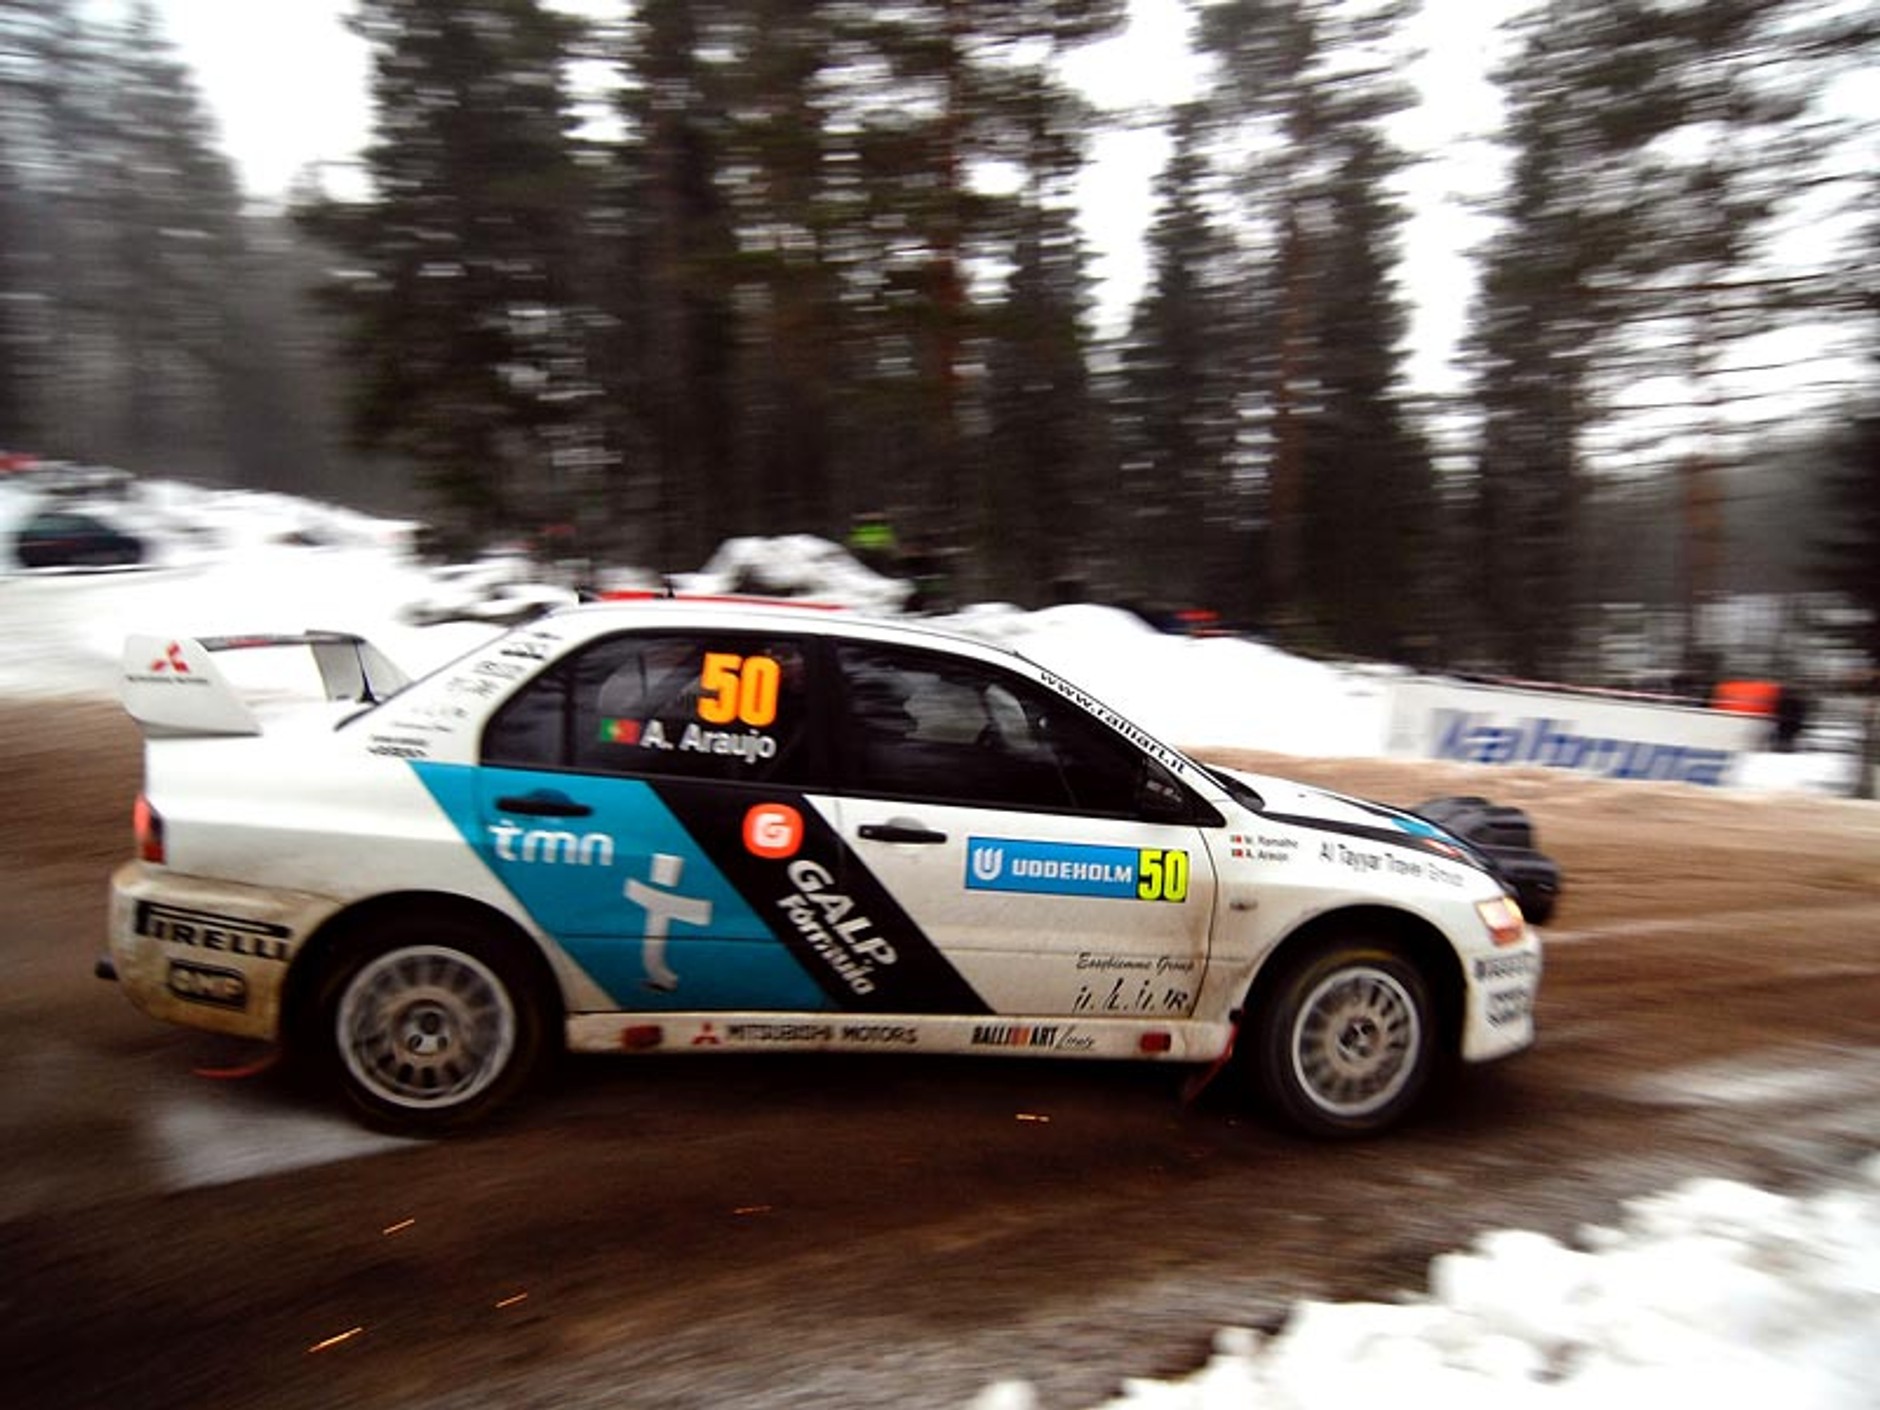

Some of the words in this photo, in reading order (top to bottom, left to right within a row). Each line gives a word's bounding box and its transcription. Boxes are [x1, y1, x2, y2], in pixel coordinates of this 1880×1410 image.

[697, 652, 782, 727] 50
[640, 718, 674, 750] A.
[678, 722, 777, 764] Araujo
[1040, 672, 1187, 775] www.ralliart.it
[488, 820, 614, 867] tmn
[1011, 858, 1134, 884] UDDEHOLM
[1137, 849, 1188, 901] 50
[133, 899, 292, 962] PIRELLI
[787, 859, 898, 965] GALP
